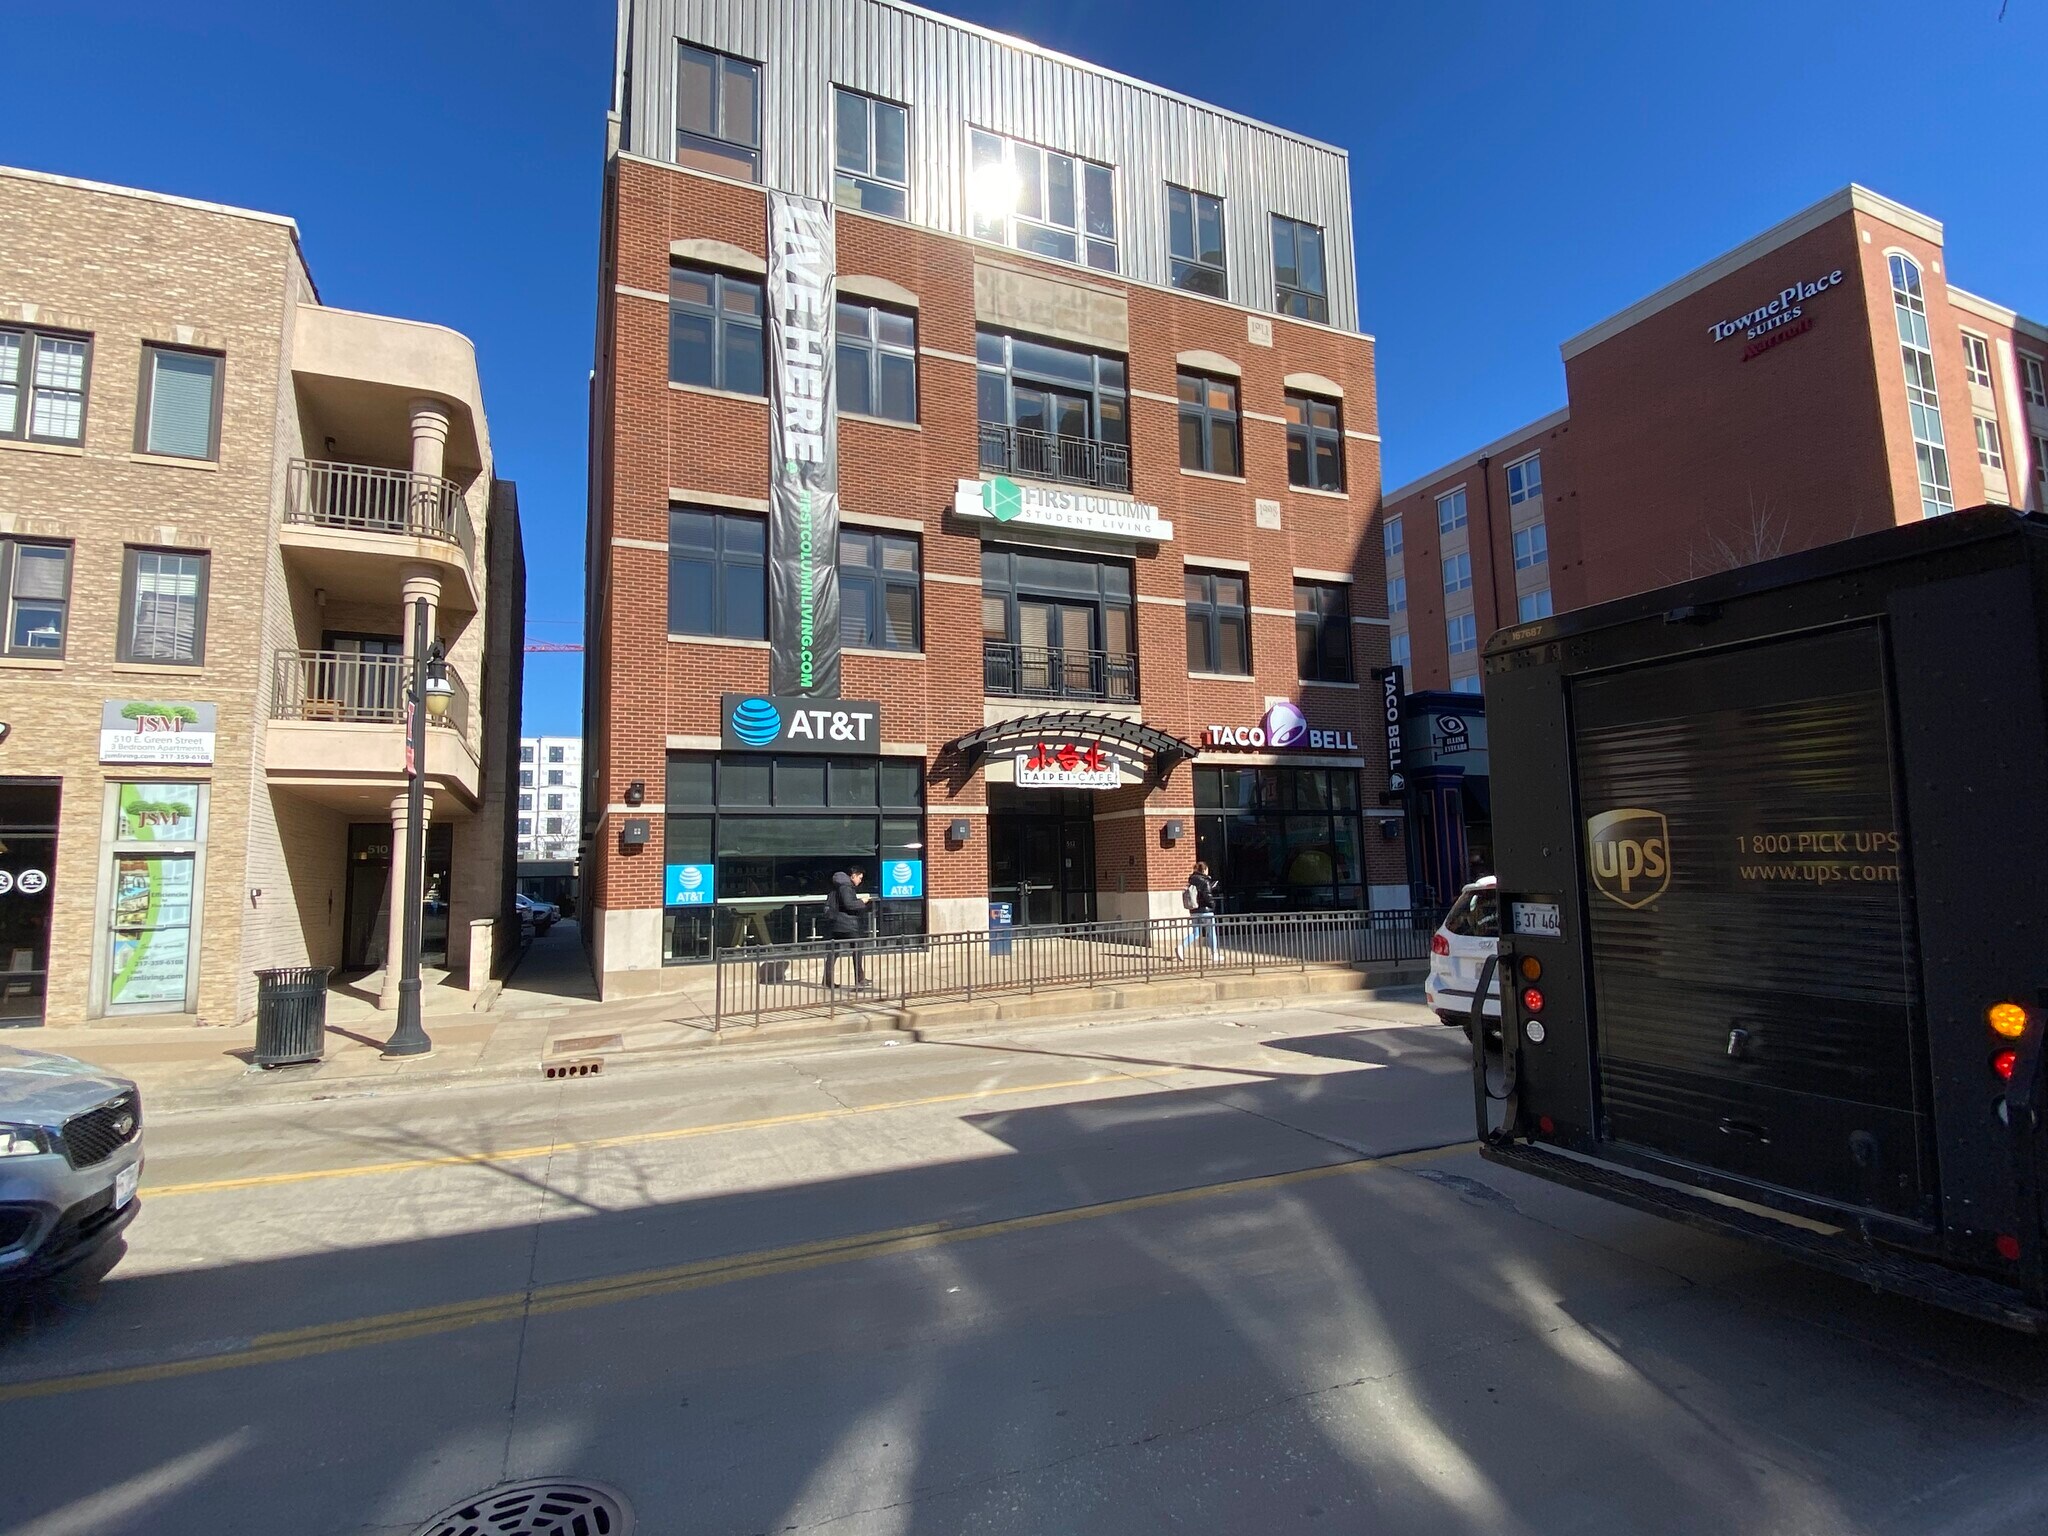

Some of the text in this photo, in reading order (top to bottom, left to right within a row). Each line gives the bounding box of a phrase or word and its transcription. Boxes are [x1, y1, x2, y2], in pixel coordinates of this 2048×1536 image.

[1707, 269, 1843, 343] TownePlace
[785, 205, 823, 463] LIVE HERE
[1747, 305, 1802, 340] SUITES
[1026, 509, 1152, 533] STUDENT LIVING
[799, 490, 814, 688] FIRSTCOLUMNLIVING.COM
[135, 715, 183, 735] JSM
[787, 709, 873, 741] AT&T
[1384, 671, 1402, 771] TACO BELL
[113, 735, 132, 743] 510
[144, 736, 173, 745] Green
[175, 737, 203, 745] Street
[1208, 725, 1358, 750] TACO BELL
[1023, 772, 1070, 781] TAIPEI
[138, 811, 180, 828] JSM
[367, 844, 389, 854] 510
[1736, 831, 1901, 854] 1 800 PICK UPS
[1595, 838, 1665, 894] ups
[1739, 865, 1900, 886] www.ups.com
[676, 891, 705, 902] AT&T
[890, 885, 915, 896] AT&T
